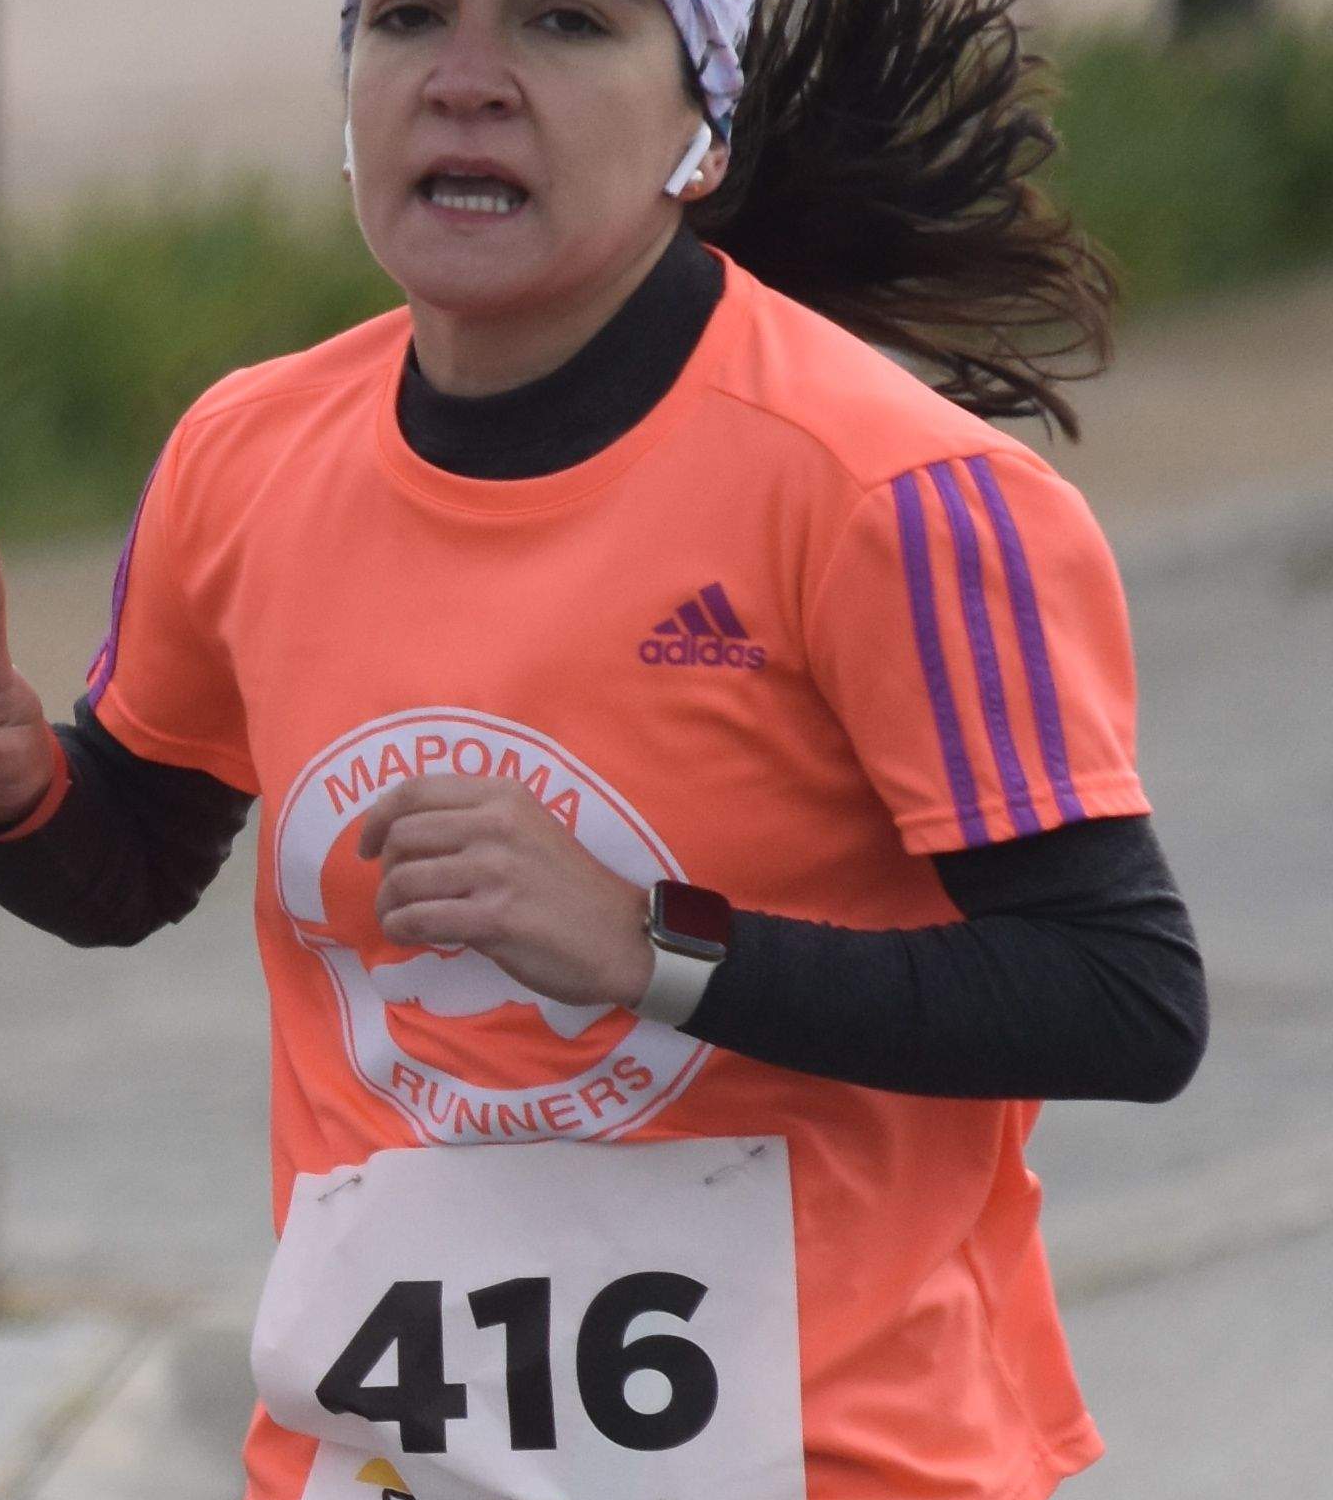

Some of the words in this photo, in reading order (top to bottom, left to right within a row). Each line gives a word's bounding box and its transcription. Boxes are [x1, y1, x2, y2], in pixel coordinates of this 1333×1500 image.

[639, 635, 766, 670] adidas
[391, 1055, 653, 1137] RUNNERS
[315, 1271, 719, 1454] 416
